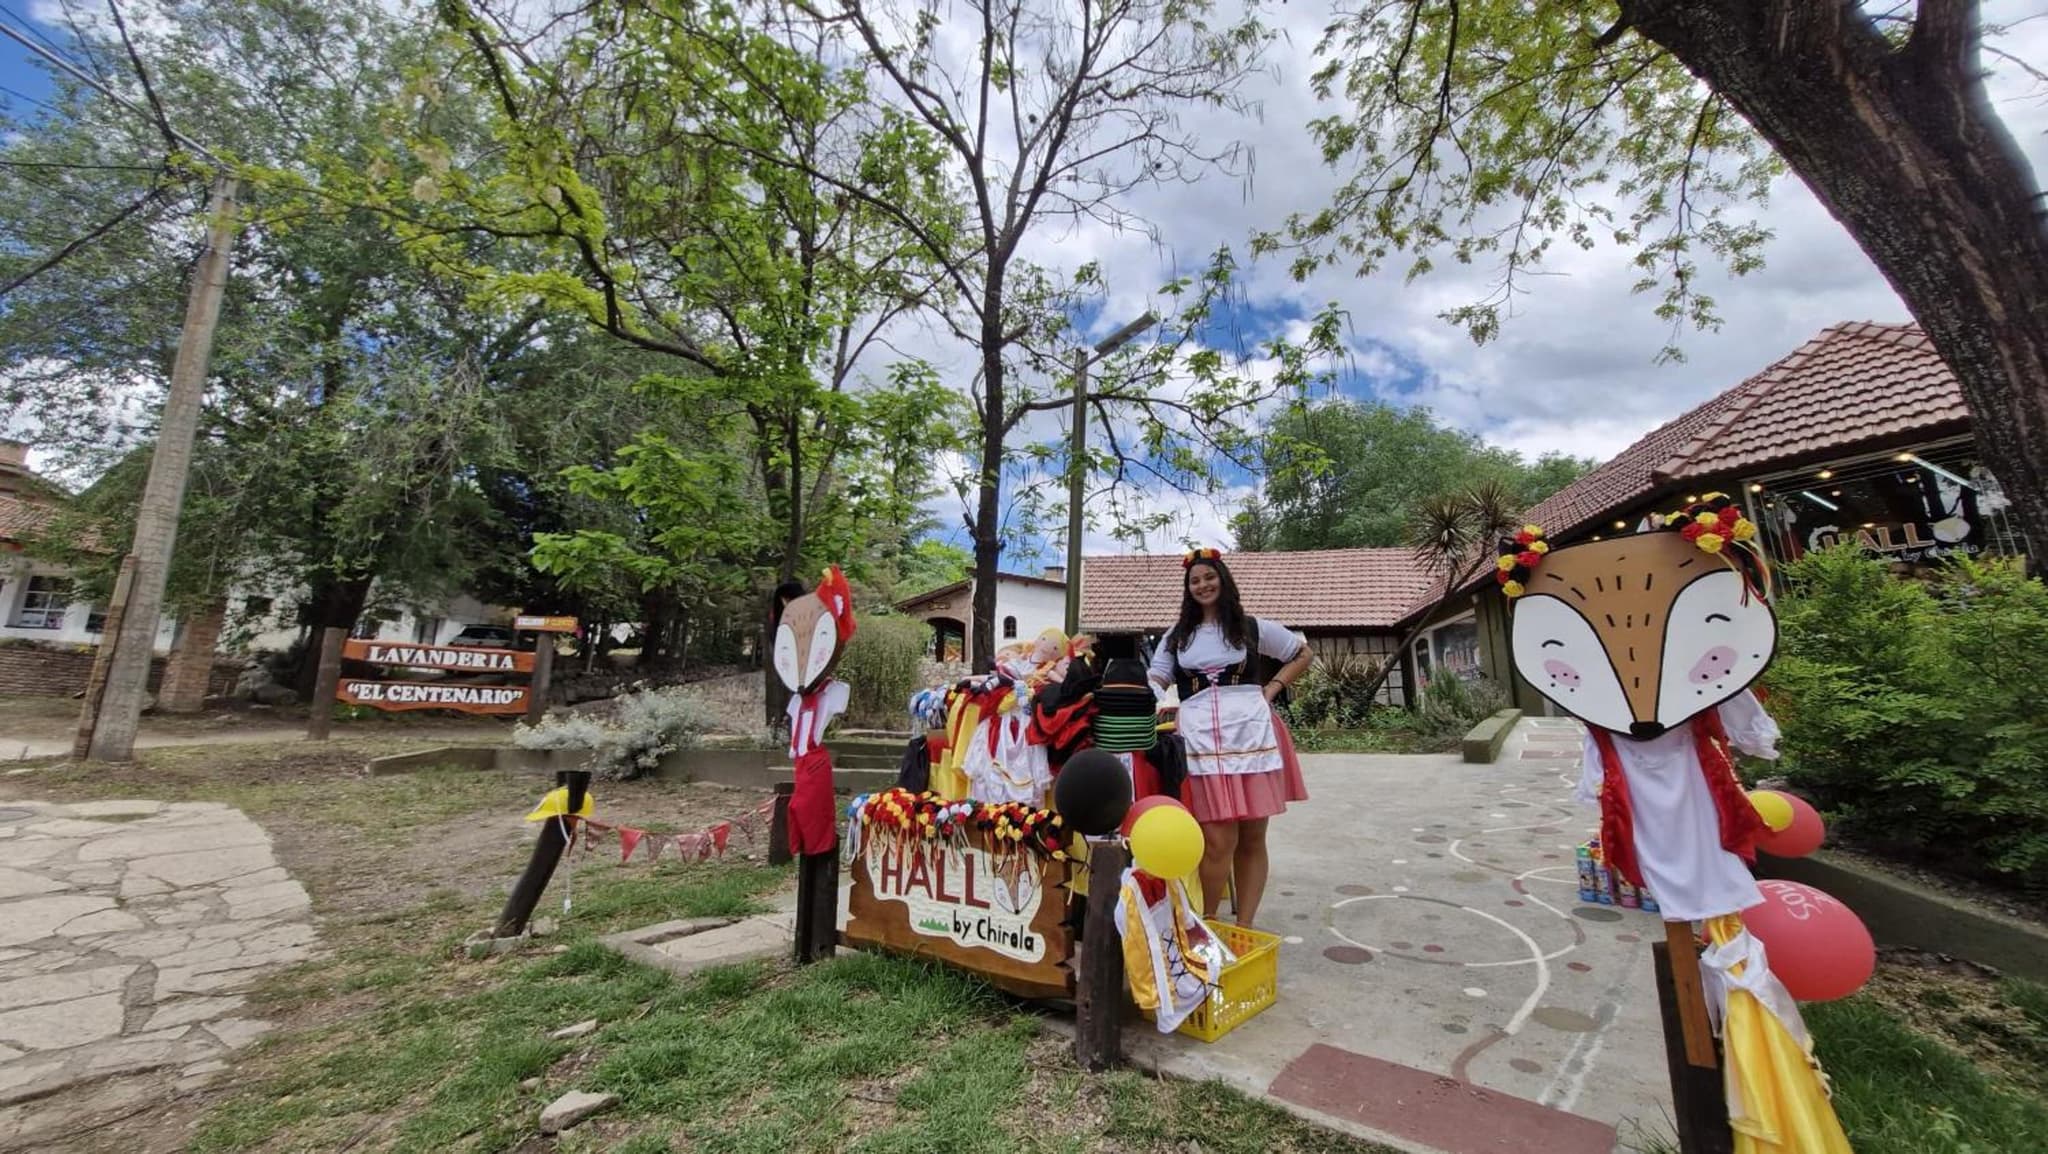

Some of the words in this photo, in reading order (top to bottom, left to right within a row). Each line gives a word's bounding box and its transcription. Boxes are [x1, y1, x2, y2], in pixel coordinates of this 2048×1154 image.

[369, 646, 514, 669] LAVANDERIA
[880, 848, 990, 909] HALL
[953, 911, 971, 940] by
[976, 916, 1034, 951] Chirola
